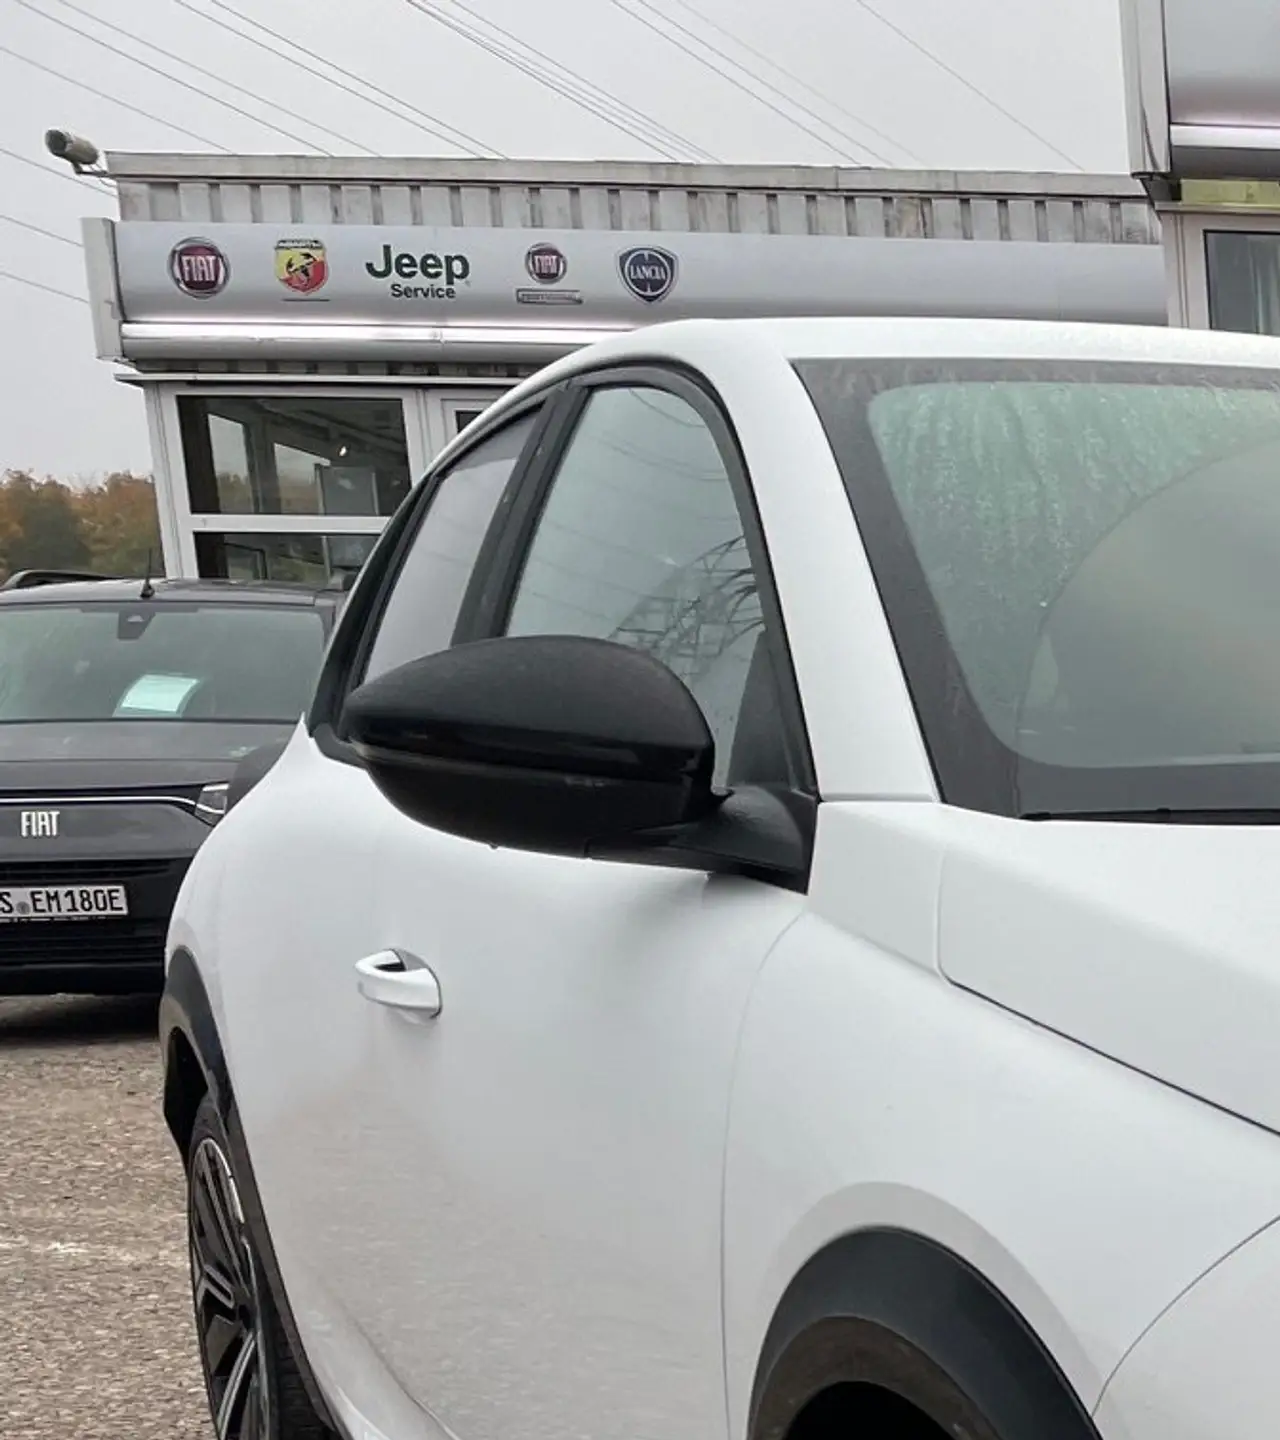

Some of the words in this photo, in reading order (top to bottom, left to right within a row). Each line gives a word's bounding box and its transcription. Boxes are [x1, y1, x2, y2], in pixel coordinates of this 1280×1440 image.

[181, 255, 216, 282] FIAT
[365, 244, 470, 285] Jeep
[534, 255, 559, 274] FIAT
[630, 264, 666, 280] LANCIA
[390, 284, 456, 300] Service
[20, 811, 60, 837] FIAT
